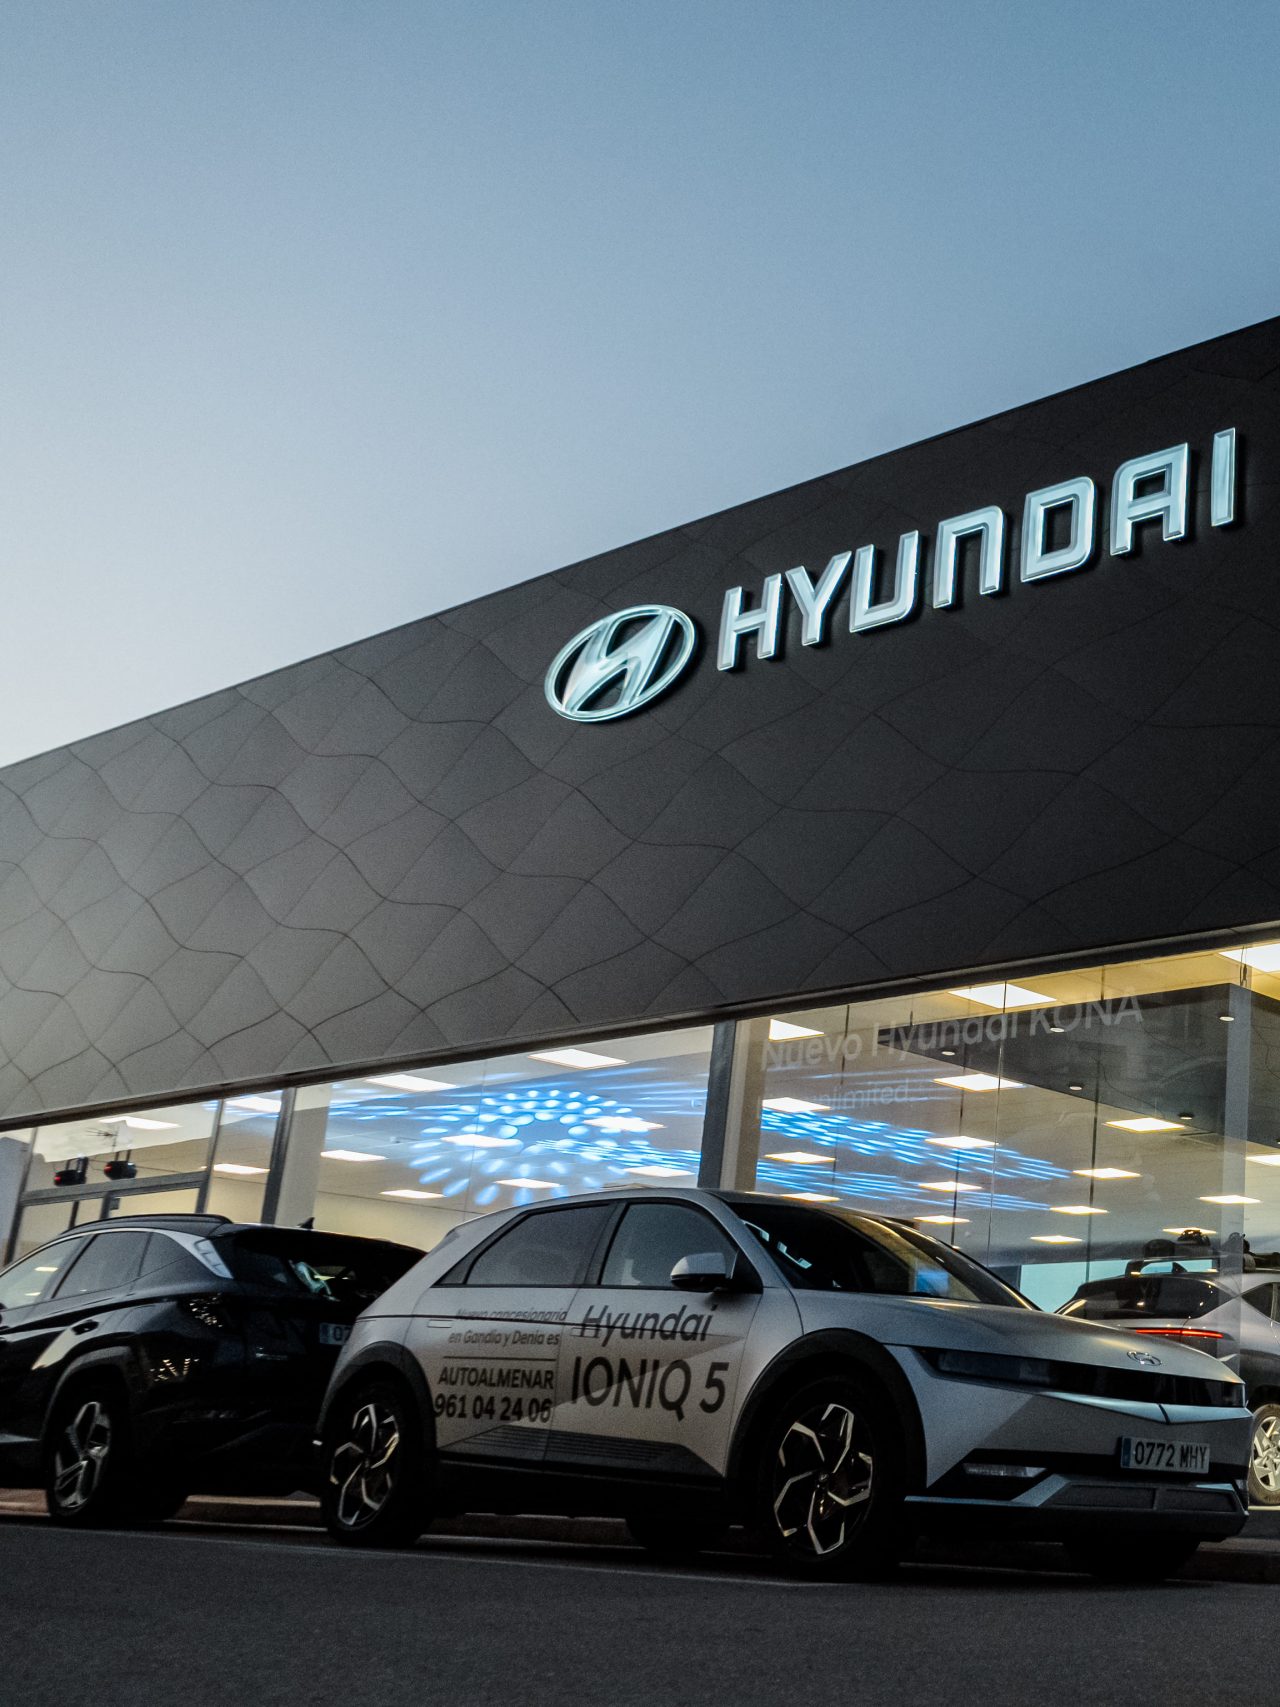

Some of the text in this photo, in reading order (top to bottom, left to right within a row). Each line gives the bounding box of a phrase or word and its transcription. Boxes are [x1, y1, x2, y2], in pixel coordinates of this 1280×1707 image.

[716, 427, 1238, 671] HYUNDAI
[760, 985, 1144, 1071] Nuevo Hyundai KONA
[448, 1332, 462, 1344] en
[501, 1332, 511, 1348] y
[546, 1333, 560, 1346] es
[580, 1305, 718, 1346] Hyundai
[438, 1366, 554, 1389] AUTOALMENAR
[571, 1356, 730, 1421] IONIQ 5
[434, 1393, 551, 1423] 961 04 24 06
[1134, 1440, 1208, 1469] 0772 MHY
